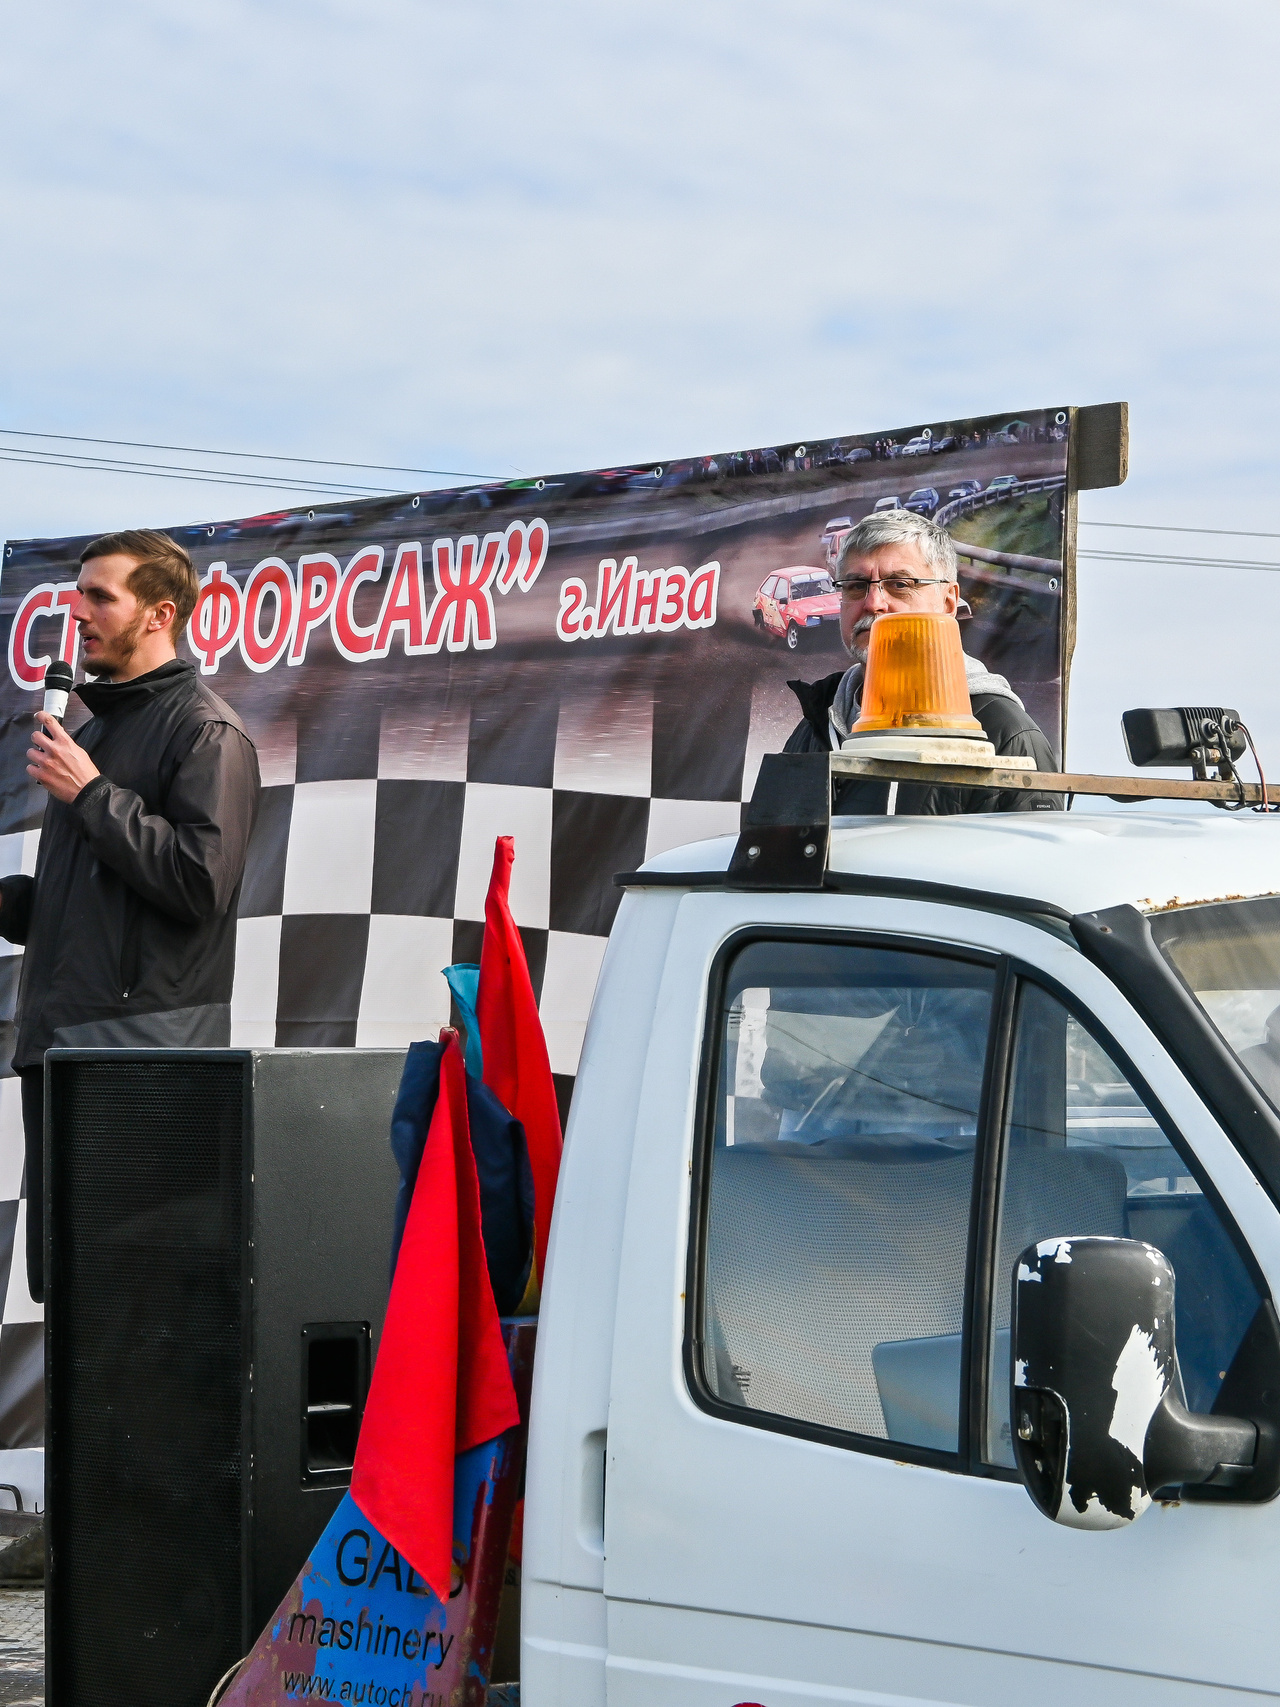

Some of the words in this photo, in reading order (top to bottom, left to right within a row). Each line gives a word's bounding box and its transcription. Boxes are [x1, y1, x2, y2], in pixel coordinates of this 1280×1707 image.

[9, 582, 98, 690] СТ
[187, 518, 549, 675] ФОРСАЖ”
[558, 557, 719, 641] г.Инза
[287, 1606, 454, 1670] mashinery
